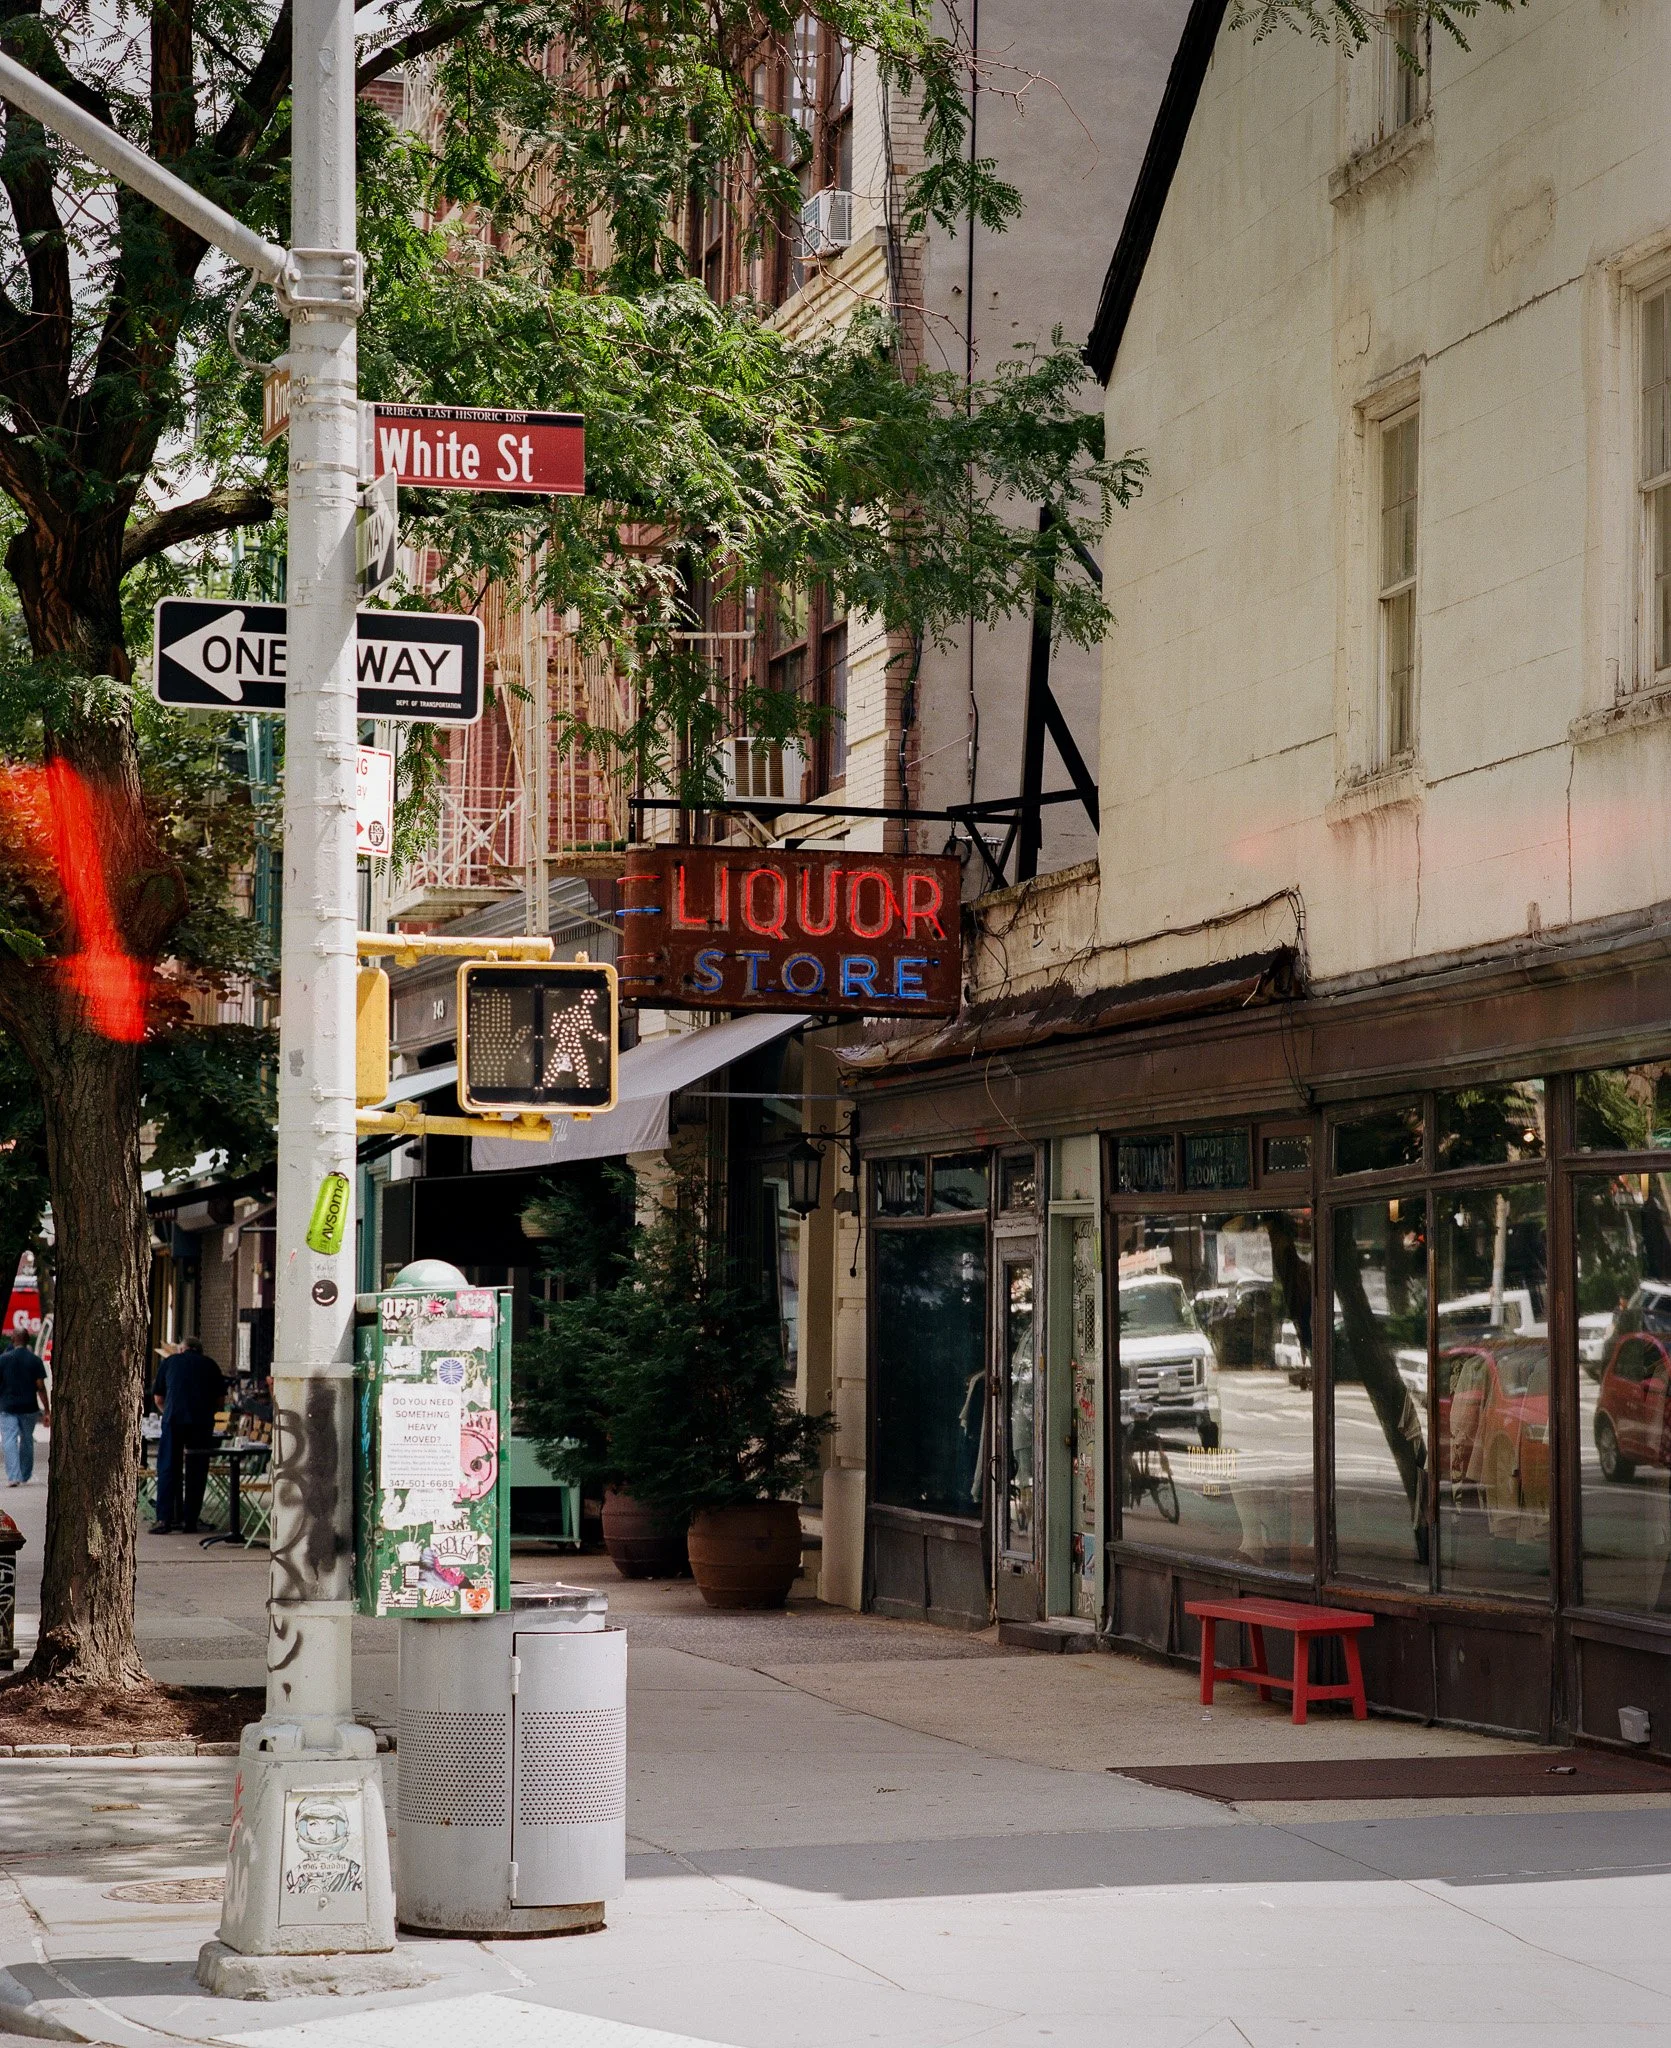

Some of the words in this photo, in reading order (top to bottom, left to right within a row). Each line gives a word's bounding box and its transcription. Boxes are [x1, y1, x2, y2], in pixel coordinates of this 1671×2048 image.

[265, 383, 272, 431] W
[274, 379, 290, 425] Broa
[379, 405, 424, 418] TRIBECA
[427, 408, 451, 419] EAST
[455, 410, 503, 422] HISTORIC
[505, 413, 529, 423] DIST
[379, 427, 480, 480] White
[496, 433, 534, 483] St
[202, 635, 286, 677] ONE
[357, 645, 451, 686] WAY
[420, 700, 462, 709] TRANSPORTATION
[672, 860, 947, 941] LIQUOR
[693, 950, 929, 999] STORE
[392, 1397, 406, 1406] DO
[408, 1397, 427, 1406] YOU
[429, 1398, 454, 1406] NEED
[395, 1410, 450, 1419] SOMETHING
[407, 1423, 438, 1431] HEAVY
[403, 1435, 441, 1443] MOVED?
[389, 1480, 454, 1488] 347-501-6689
